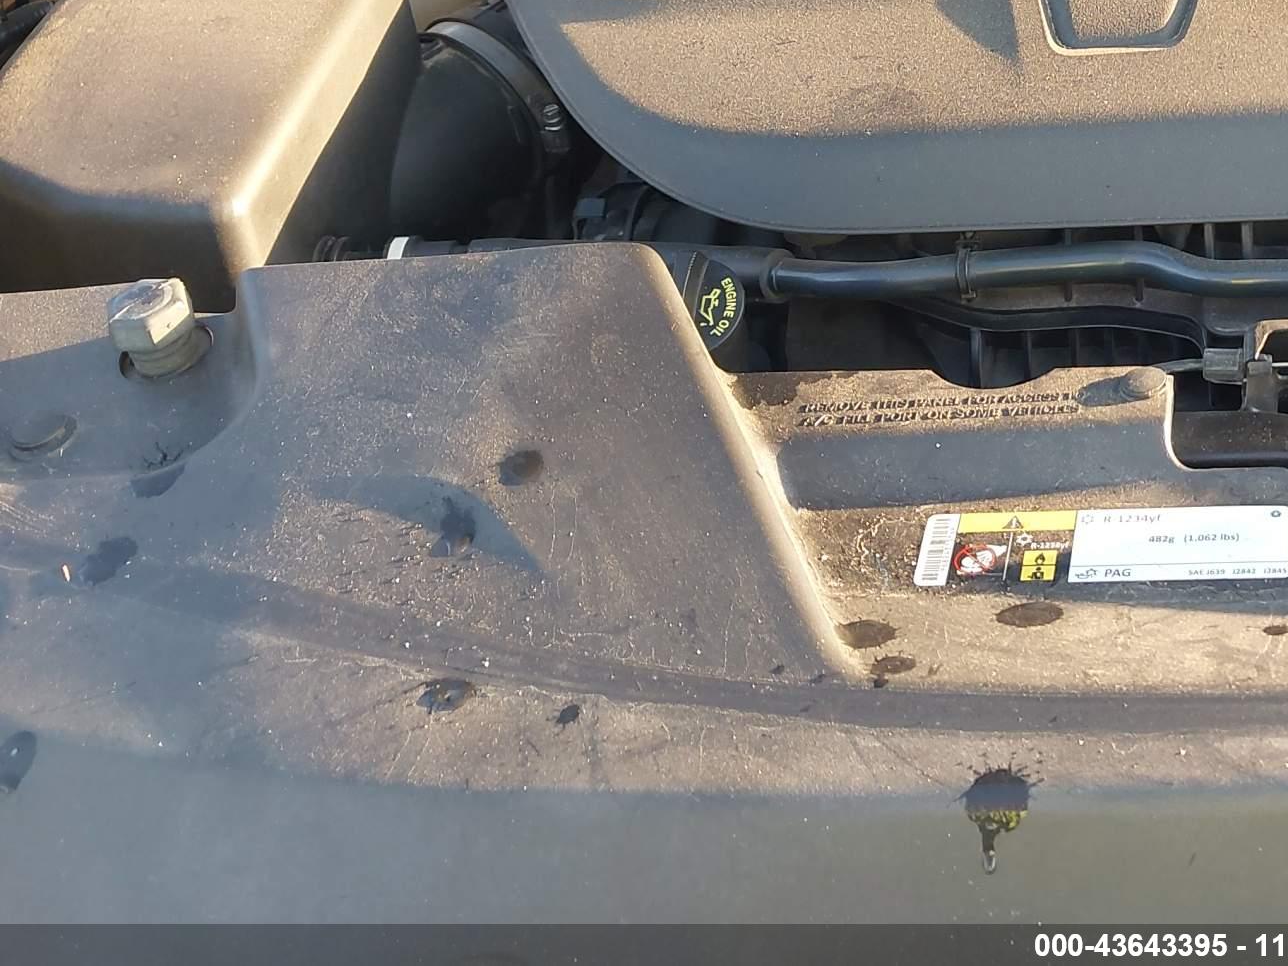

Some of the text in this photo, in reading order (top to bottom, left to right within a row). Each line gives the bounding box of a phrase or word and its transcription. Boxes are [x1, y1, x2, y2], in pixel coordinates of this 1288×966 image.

[710, 277, 737, 336] ENGINE OIL
[804, 400, 870, 413] REMOVE
[913, 395, 959, 410] PANEL
[964, 394, 998, 406] FOR
[1000, 392, 1060, 404] ACCESS
[925, 408, 949, 421] ON
[952, 406, 1001, 419] SOME
[1006, 403, 1081, 417] VEHICLES
[1103, 513, 1161, 524] R1234yf
[1148, 532, 1240, 544] 482g (1.062 lbs)
[1104, 568, 1132, 578] PAG
